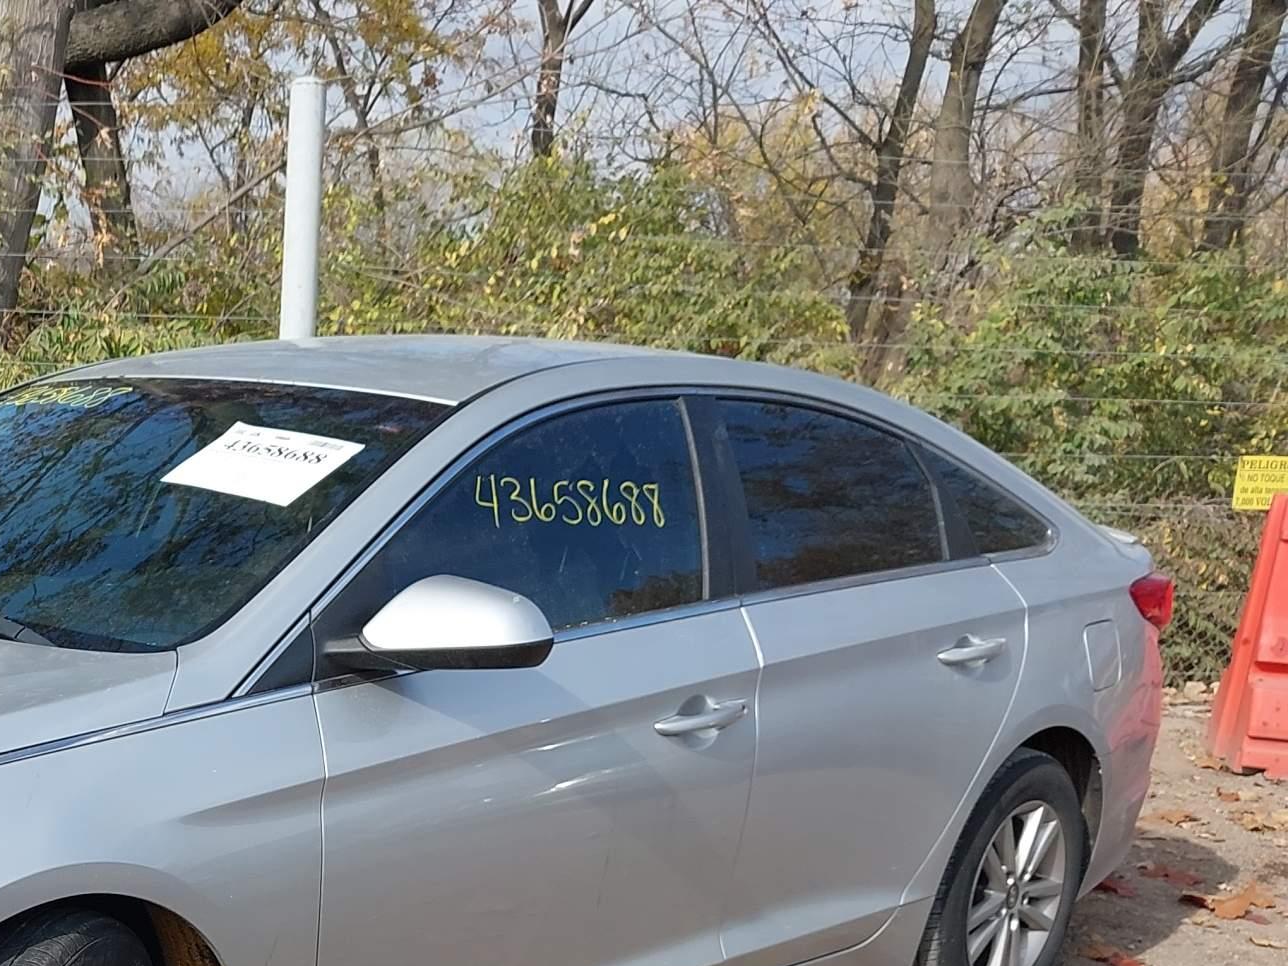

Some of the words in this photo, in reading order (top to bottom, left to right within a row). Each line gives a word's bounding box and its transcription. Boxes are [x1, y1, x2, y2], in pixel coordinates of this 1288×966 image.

[224, 439, 328, 464] 43658688
[1247, 473, 1259, 482] NO
[475, 474, 665, 529] 43658688
